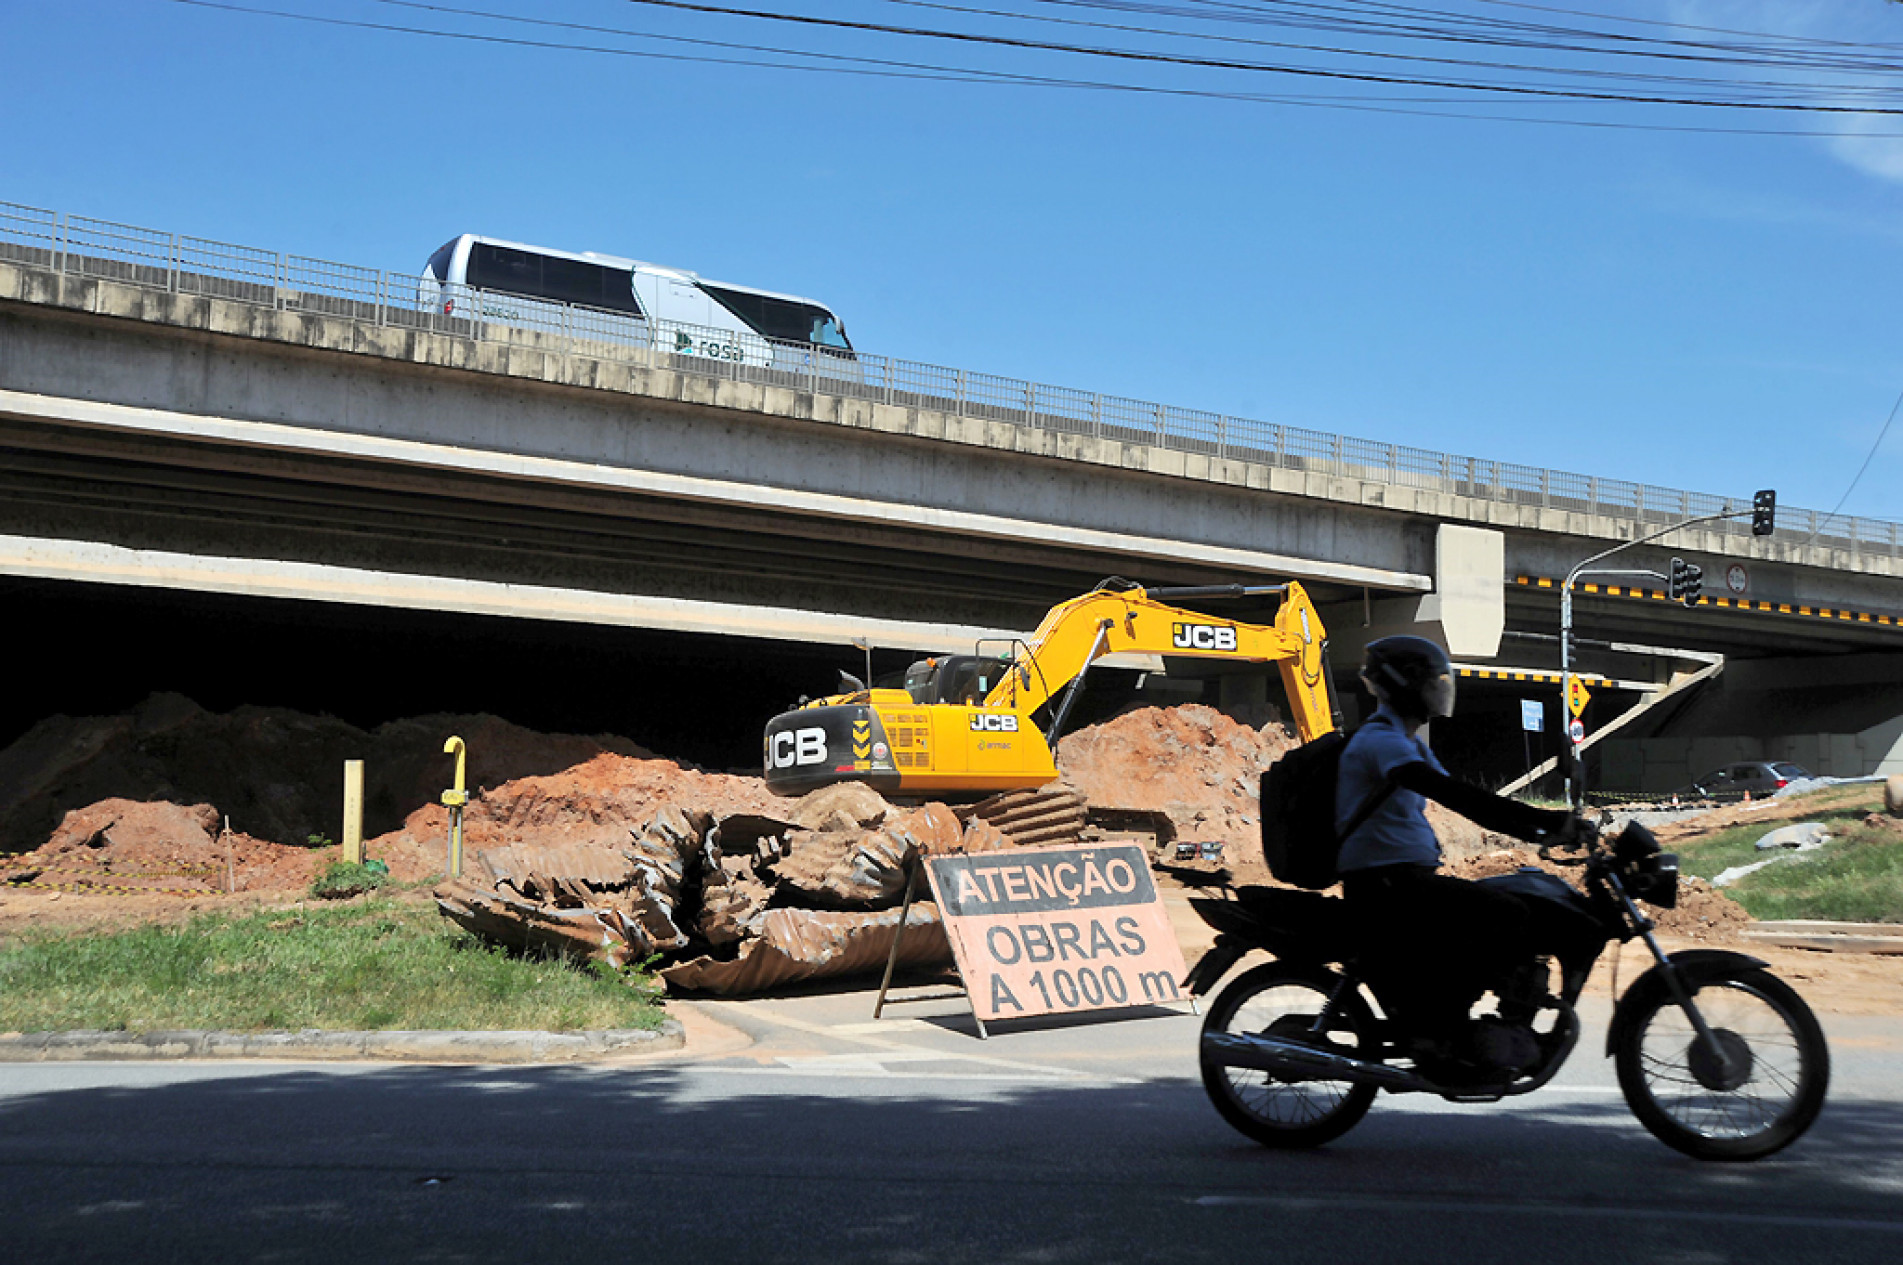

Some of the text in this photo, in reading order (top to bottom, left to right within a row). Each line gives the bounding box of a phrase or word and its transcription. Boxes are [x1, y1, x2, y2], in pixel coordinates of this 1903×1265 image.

[1174, 624, 1236, 649] JCB
[971, 714, 1018, 731] JCB
[766, 727, 828, 770] JCB
[958, 853, 1136, 905] ATENÇÃO
[986, 916, 1146, 965] OBRAS
[991, 965, 1180, 1013] A 1000 m
